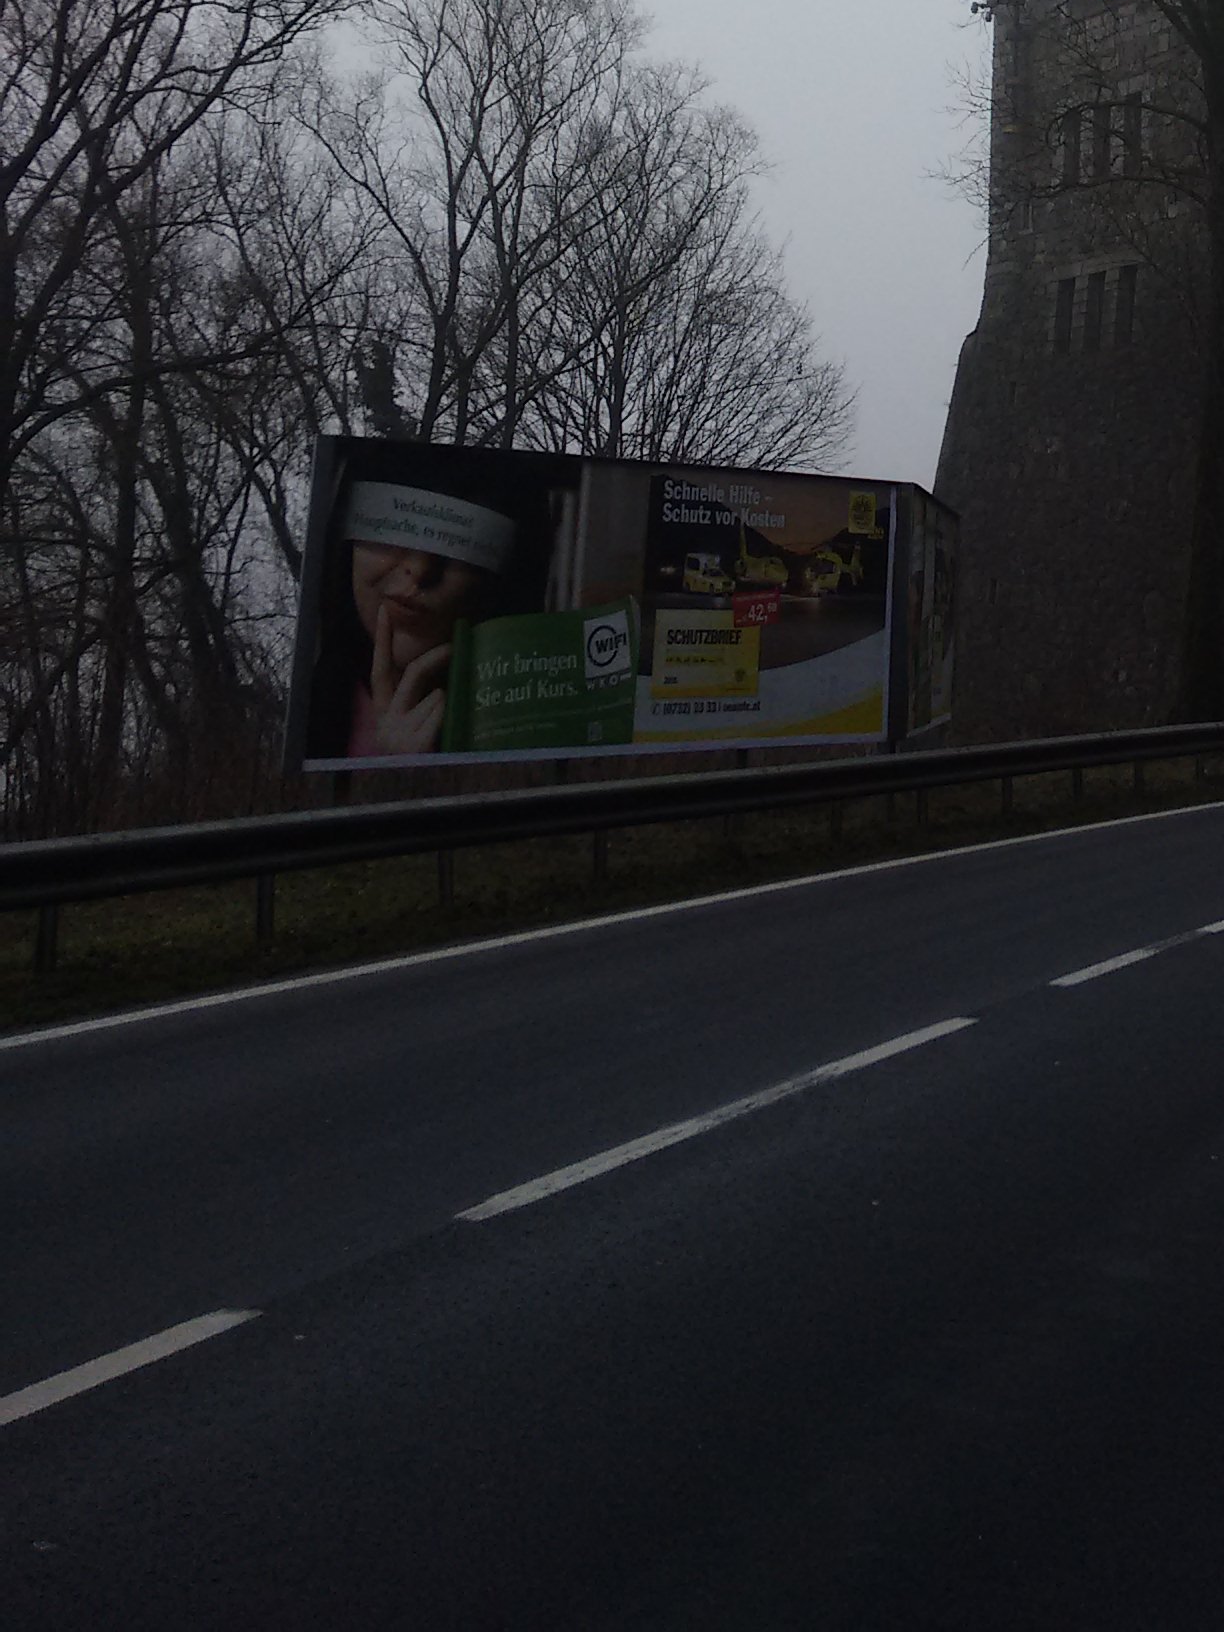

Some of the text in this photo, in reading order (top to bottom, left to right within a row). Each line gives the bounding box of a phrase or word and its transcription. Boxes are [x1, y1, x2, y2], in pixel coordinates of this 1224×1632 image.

[663, 480, 725, 503] Schnelle
[729, 485, 761, 505] Hilfe
[662, 503, 786, 528] Schutz vor Kosten
[595, 632, 627, 655] WIFI
[667, 629, 742, 645] SCHUTZBRIEF
[476, 651, 577, 681] Wir bringen
[475, 679, 579, 711] Sie auf Kurs.
